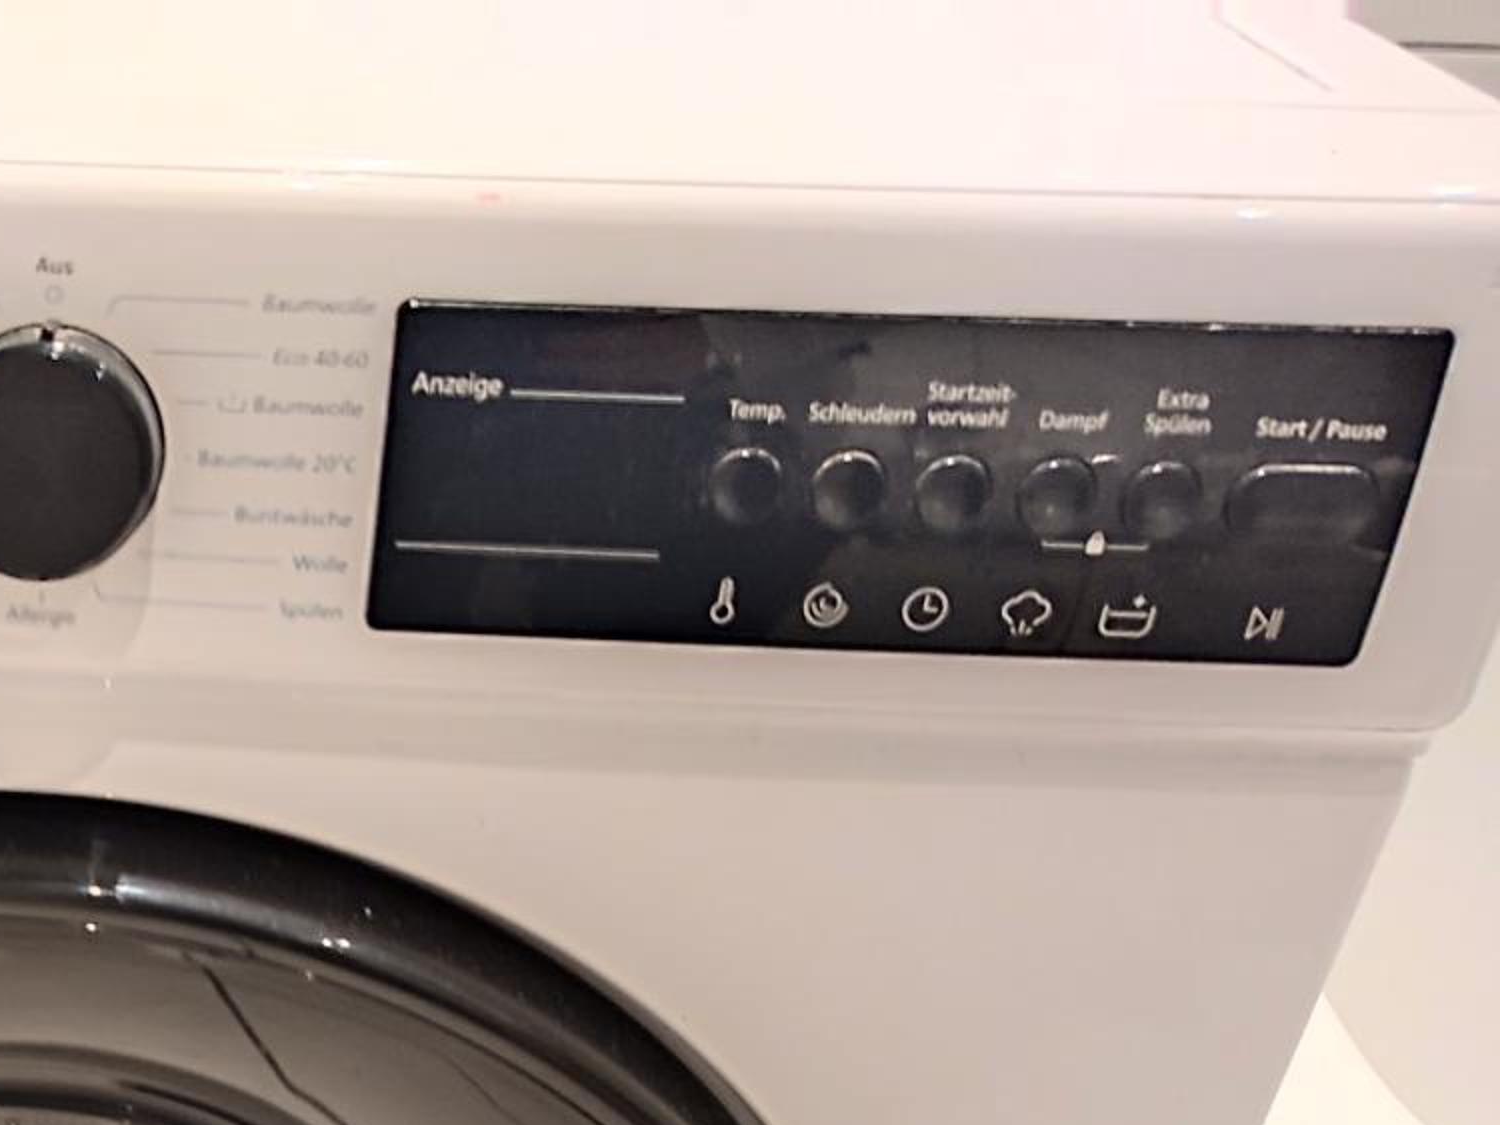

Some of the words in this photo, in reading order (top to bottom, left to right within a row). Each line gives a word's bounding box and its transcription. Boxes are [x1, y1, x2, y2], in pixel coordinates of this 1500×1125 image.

[35, 256, 74, 276] Aus
[261, 293, 377, 316] Baumwolle
[272, 348, 309, 368] Eco
[411, 370, 504, 403] Anzeige
[253, 394, 365, 419] Baumwolle
[729, 398, 786, 426] Temp.
[808, 401, 917, 425] Schleudern
[1157, 389, 1211, 413] Extra
[926, 405, 1010, 428] vorwahl
[1039, 410, 1110, 435] Dampf
[1145, 412, 1212, 437] Spülen
[1256, 416, 1310, 441] Start
[1326, 420, 1387, 443] Pause
[197, 448, 306, 473] Baumwolle
[312, 453, 357, 476] 20°C
[233, 504, 355, 529] Buntwäsche
[292, 552, 349, 575] Wolle
